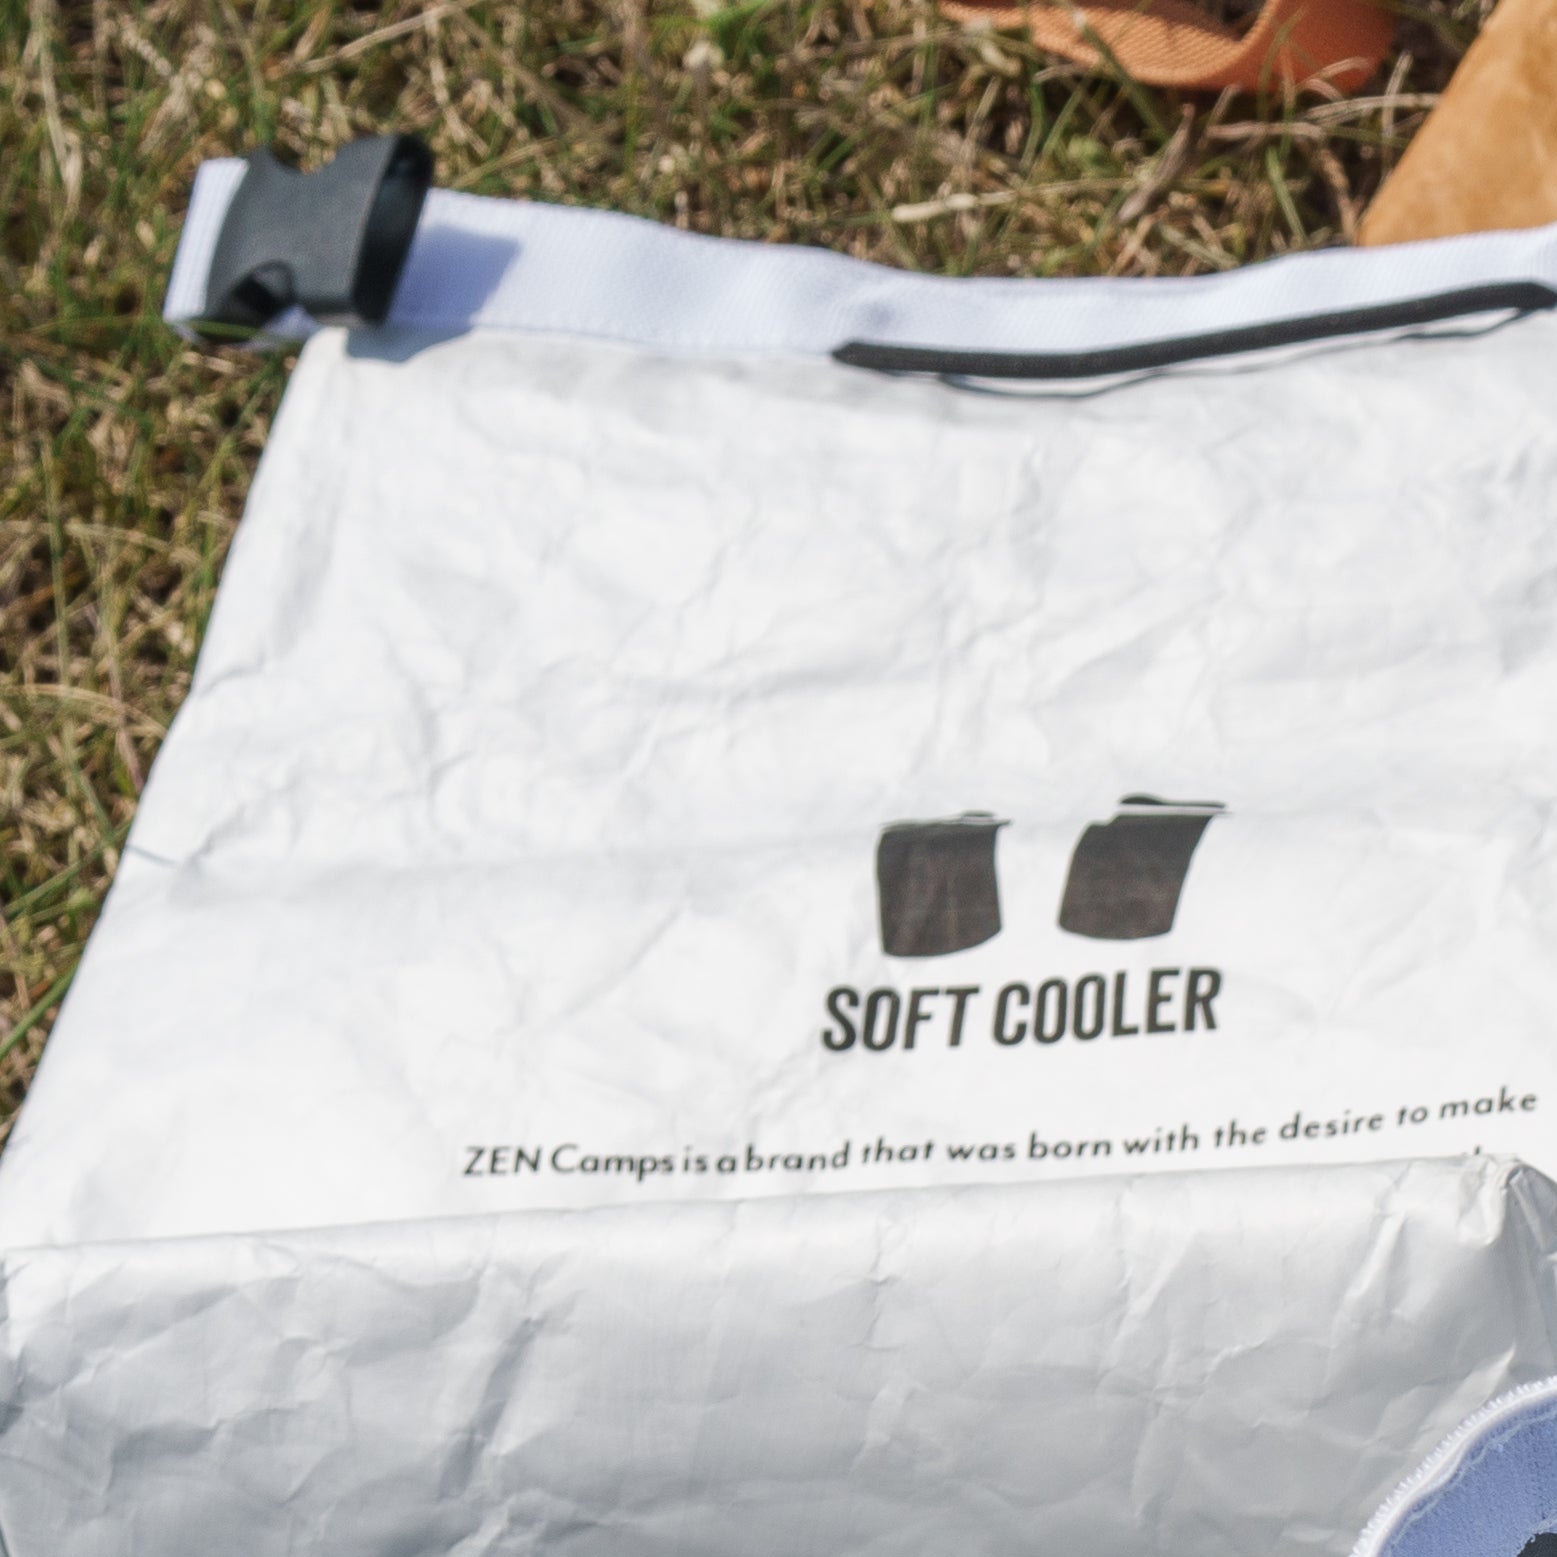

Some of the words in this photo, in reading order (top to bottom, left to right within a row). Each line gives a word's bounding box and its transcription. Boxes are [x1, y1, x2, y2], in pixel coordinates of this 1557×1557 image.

[822, 984, 980, 1052] SOFT
[991, 966, 1223, 1047] COOLER
[462, 1144, 543, 1178] ZEN
[549, 1142, 674, 1184] Camps
[683, 1143, 708, 1175] is
[715, 1153, 738, 1175] a
[743, 1141, 851, 1175] brand
[861, 1136, 936, 1167] that
[946, 1142, 1016, 1164] was
[1028, 1131, 1112, 1161] born
[1123, 1124, 1200, 1156] with
[1212, 1118, 1268, 1150] the
[1279, 1109, 1384, 1143] desire
[1397, 1101, 1430, 1127] to
[1438, 1085, 1538, 1121] make
